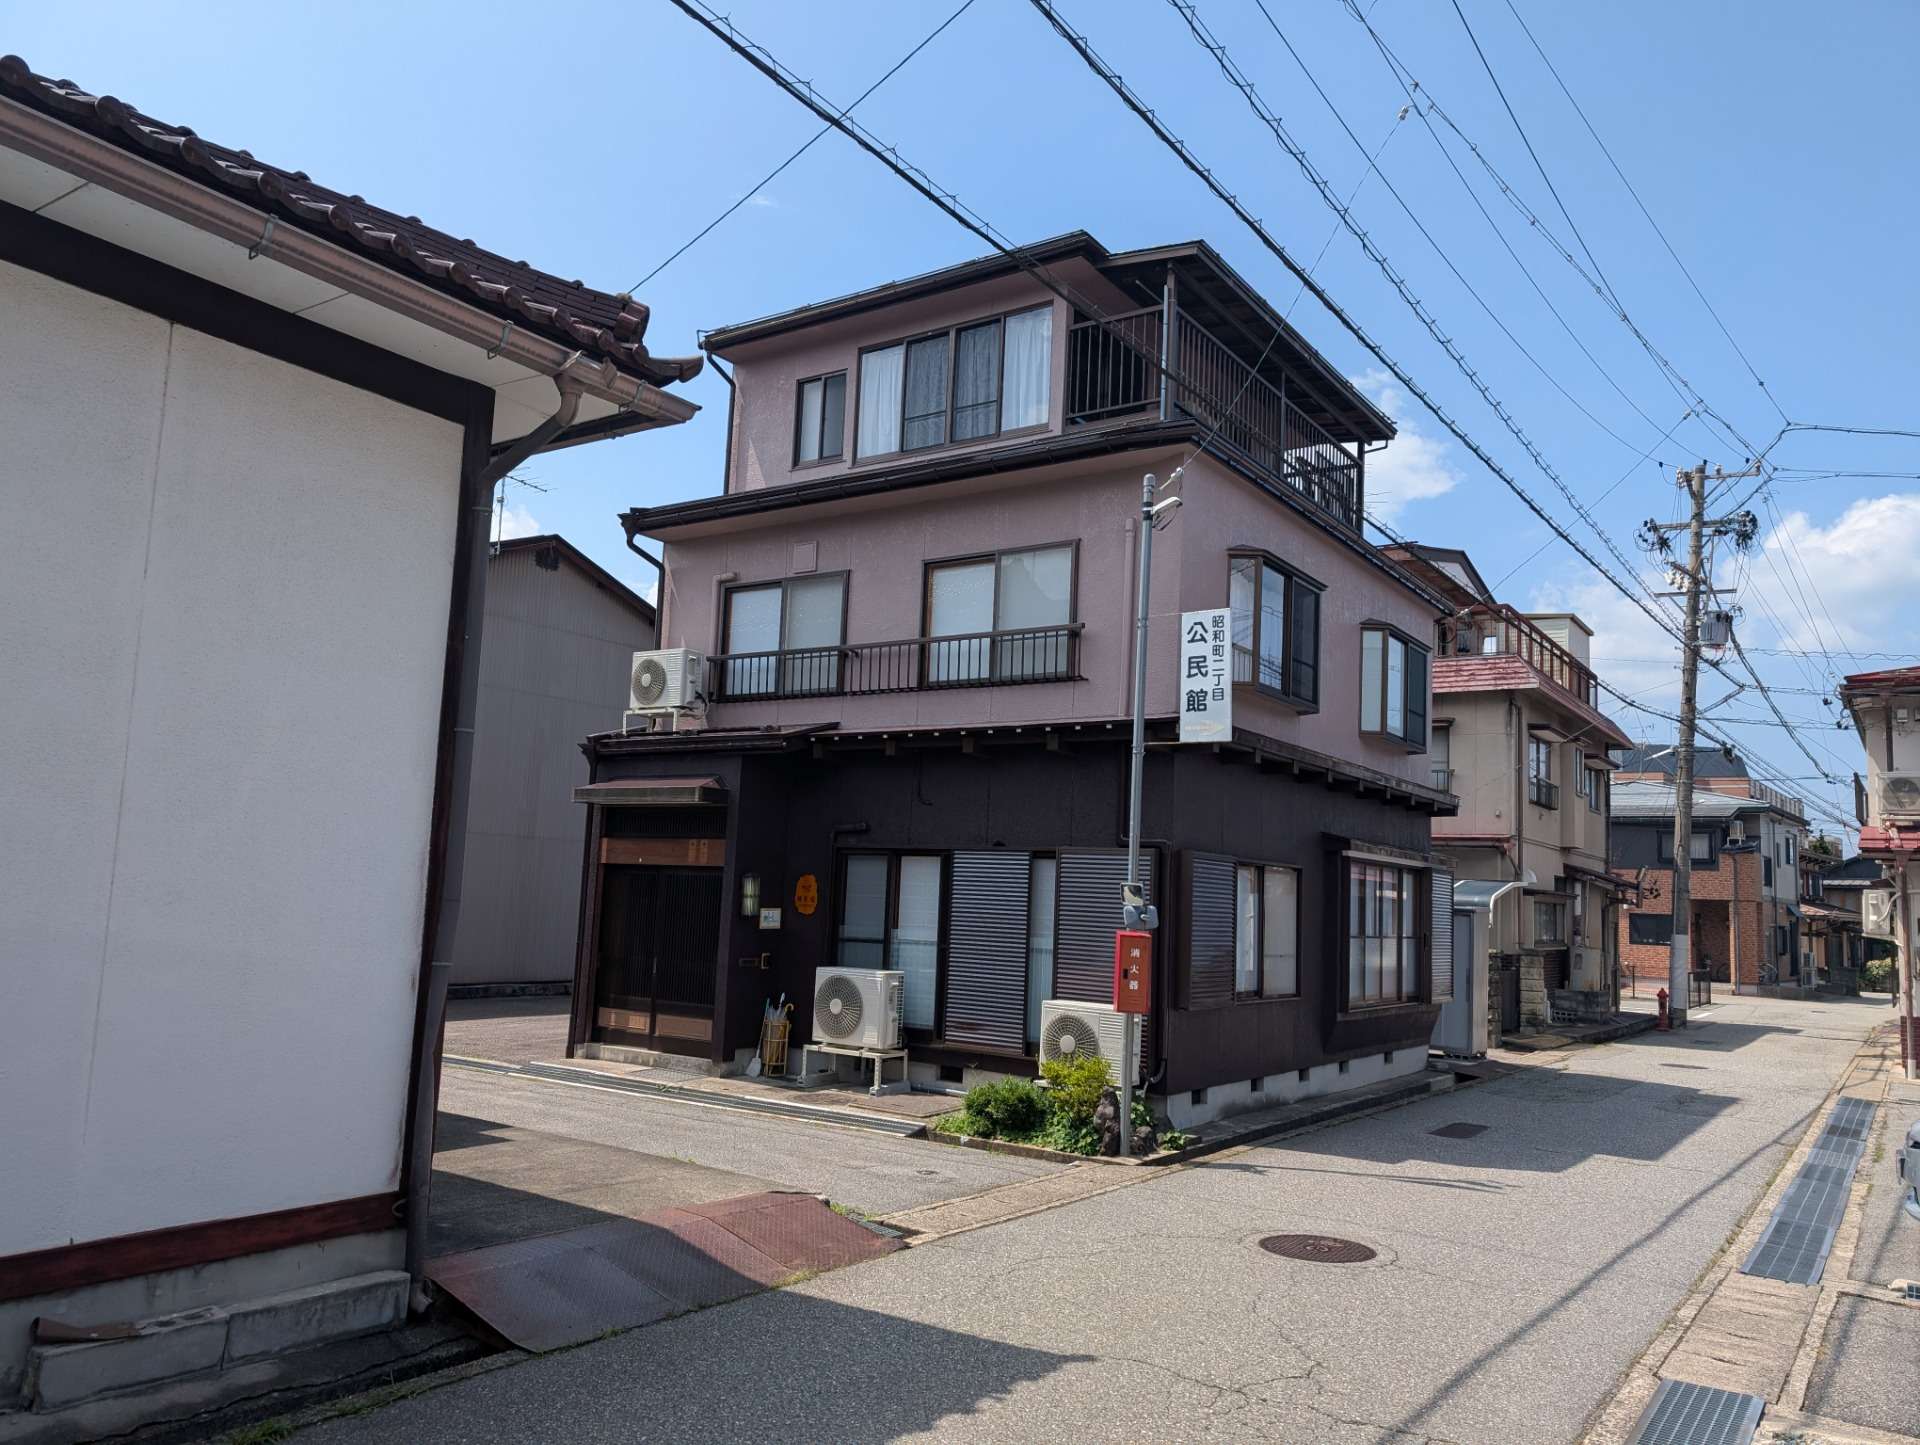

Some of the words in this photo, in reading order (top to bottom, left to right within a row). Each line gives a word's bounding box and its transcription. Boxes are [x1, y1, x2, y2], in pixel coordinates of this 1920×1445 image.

[1186, 621, 1209, 712] 公民館
[1212, 615, 1224, 701] 昭和町二丁目
[1129, 948, 1140, 990] 消火器
